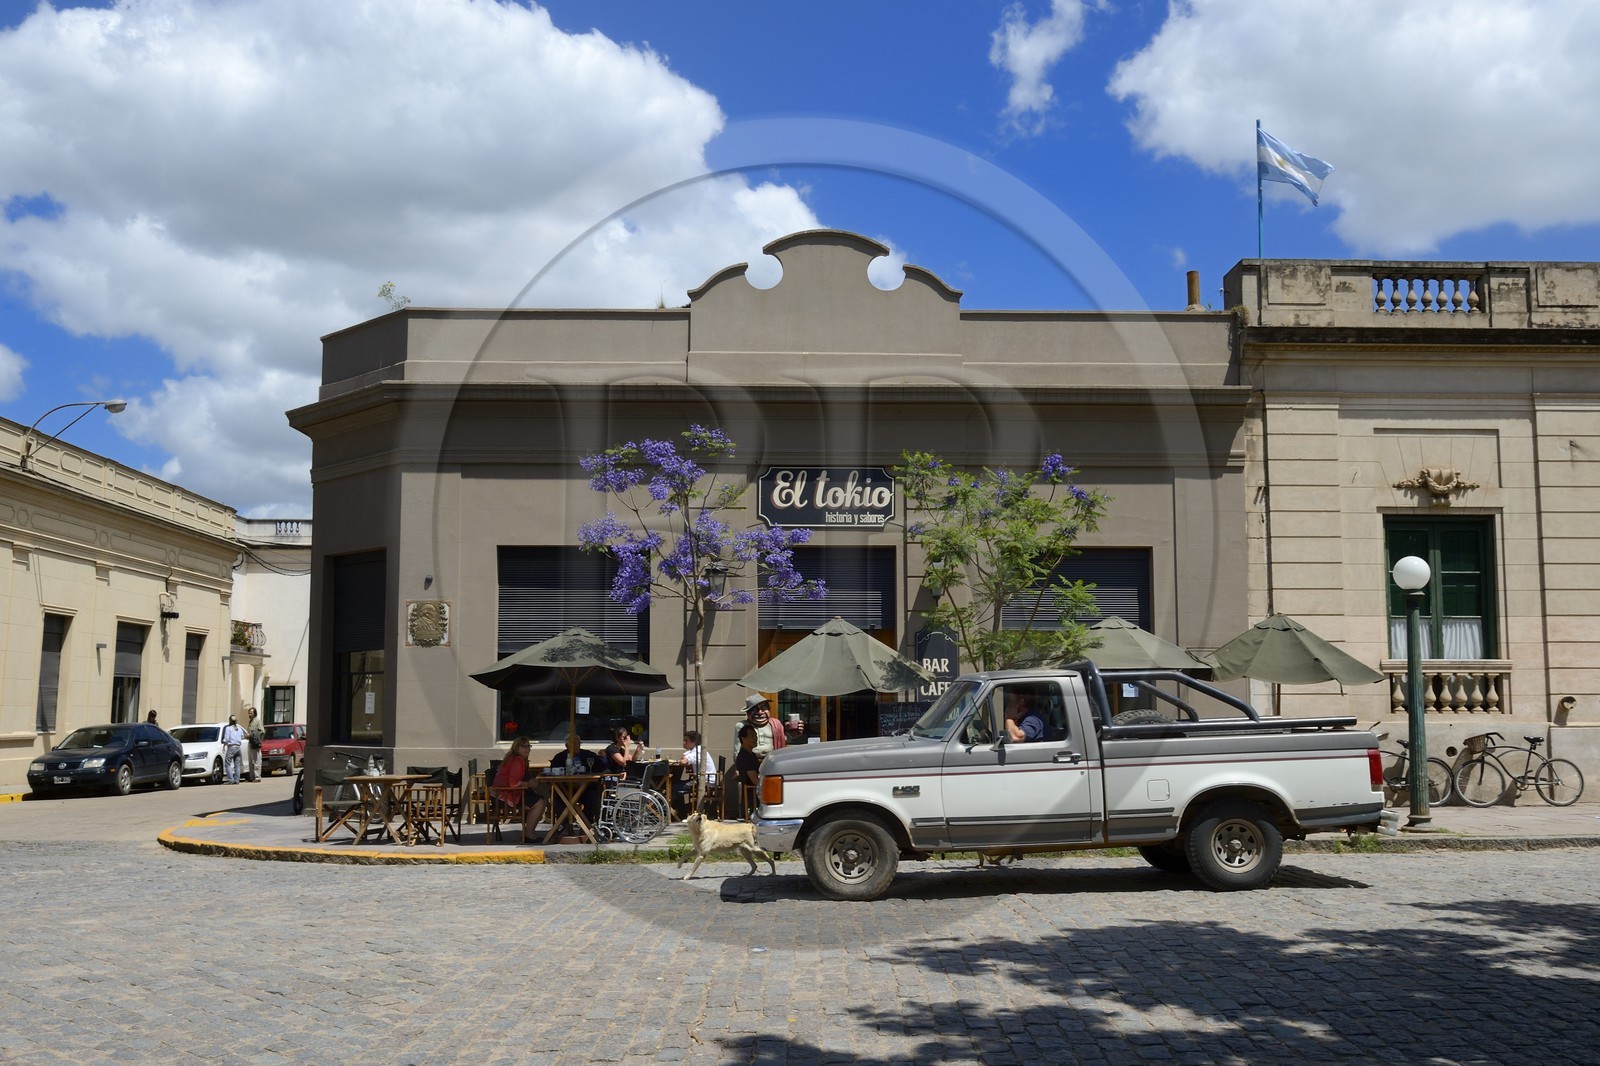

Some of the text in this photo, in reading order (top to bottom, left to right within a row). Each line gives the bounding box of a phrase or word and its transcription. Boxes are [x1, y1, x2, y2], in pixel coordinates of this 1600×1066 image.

[772, 470, 894, 508] El tokio
[825, 511, 885, 525] historia y sabores
[922, 658, 950, 673] BAR
